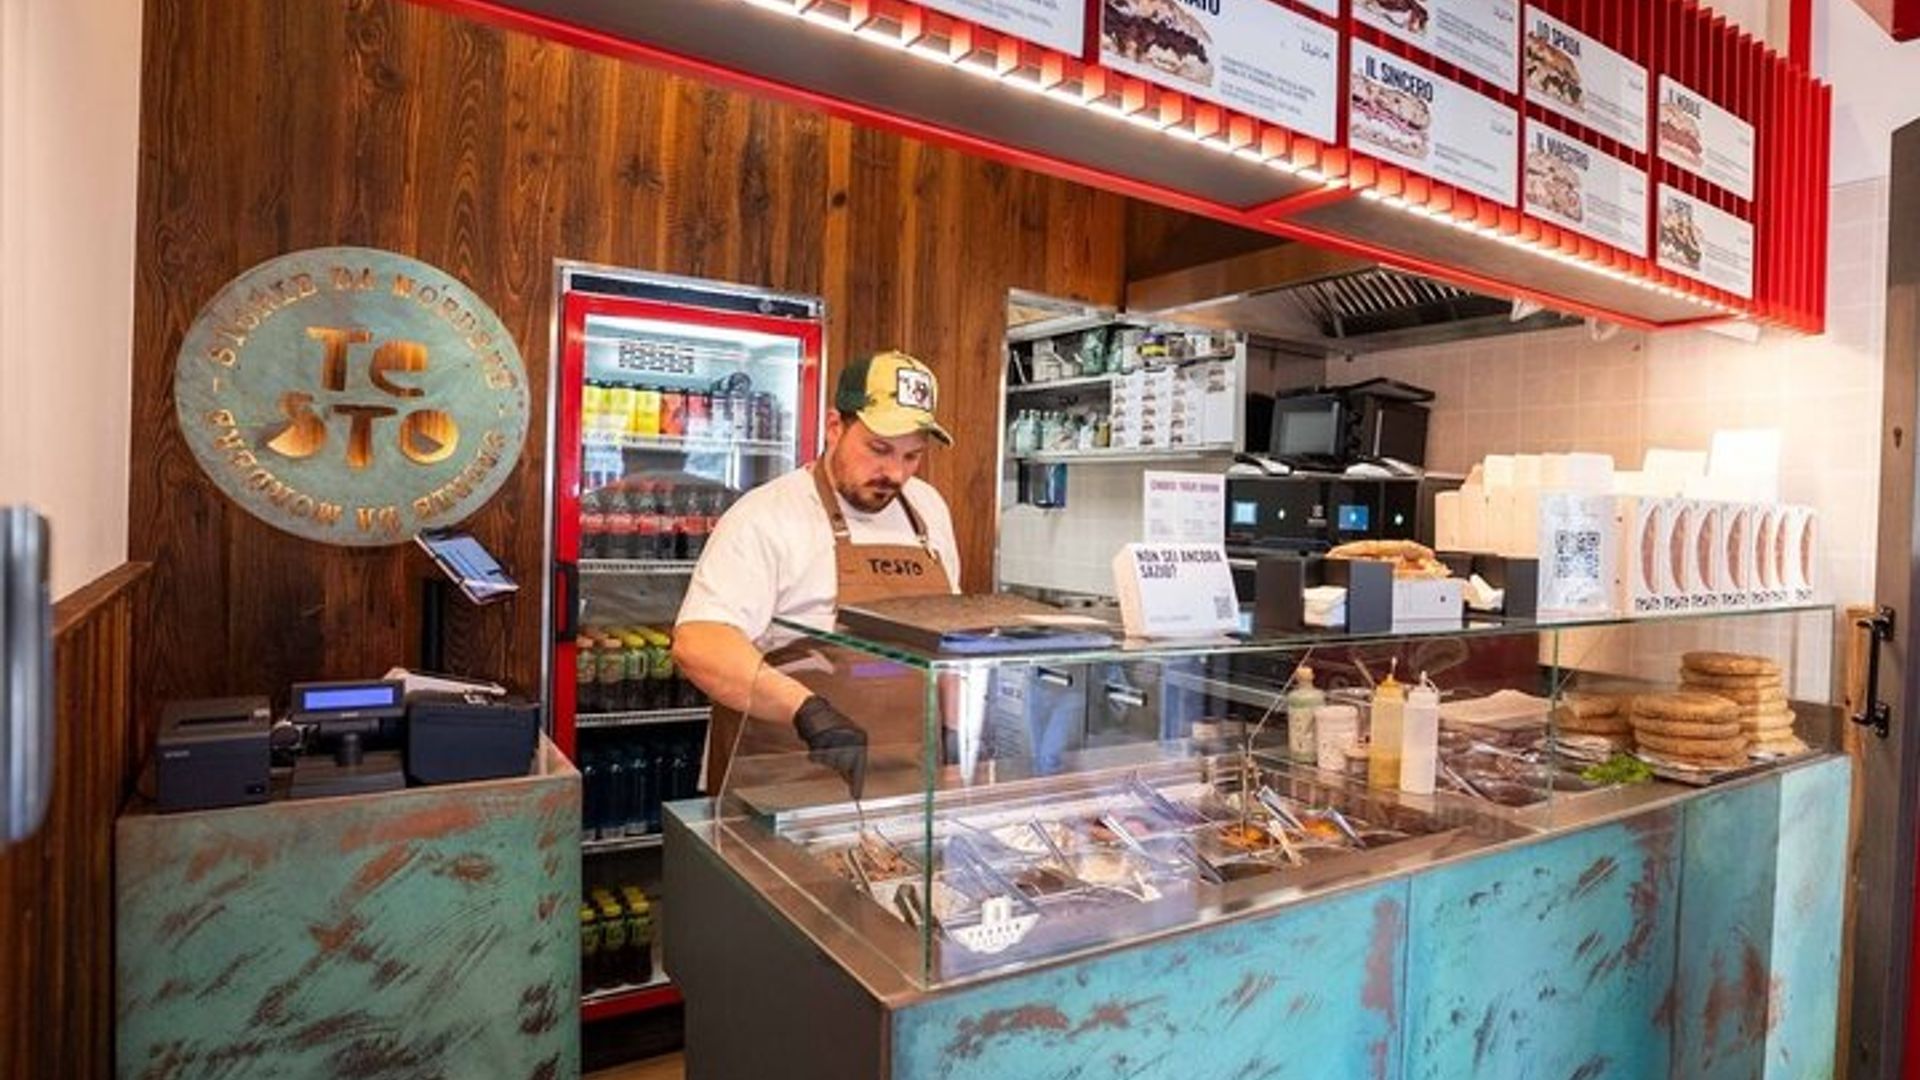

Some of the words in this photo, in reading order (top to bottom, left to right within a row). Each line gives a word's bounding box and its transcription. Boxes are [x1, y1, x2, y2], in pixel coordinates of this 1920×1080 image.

[1365, 55, 1377, 79] IL
[1381, 62, 1434, 103] SINCERO
[261, 390, 461, 471] STO
[1135, 549, 1159, 562] NON
[1160, 550, 1179, 562] SEI
[1180, 549, 1222, 563] ANCORA
